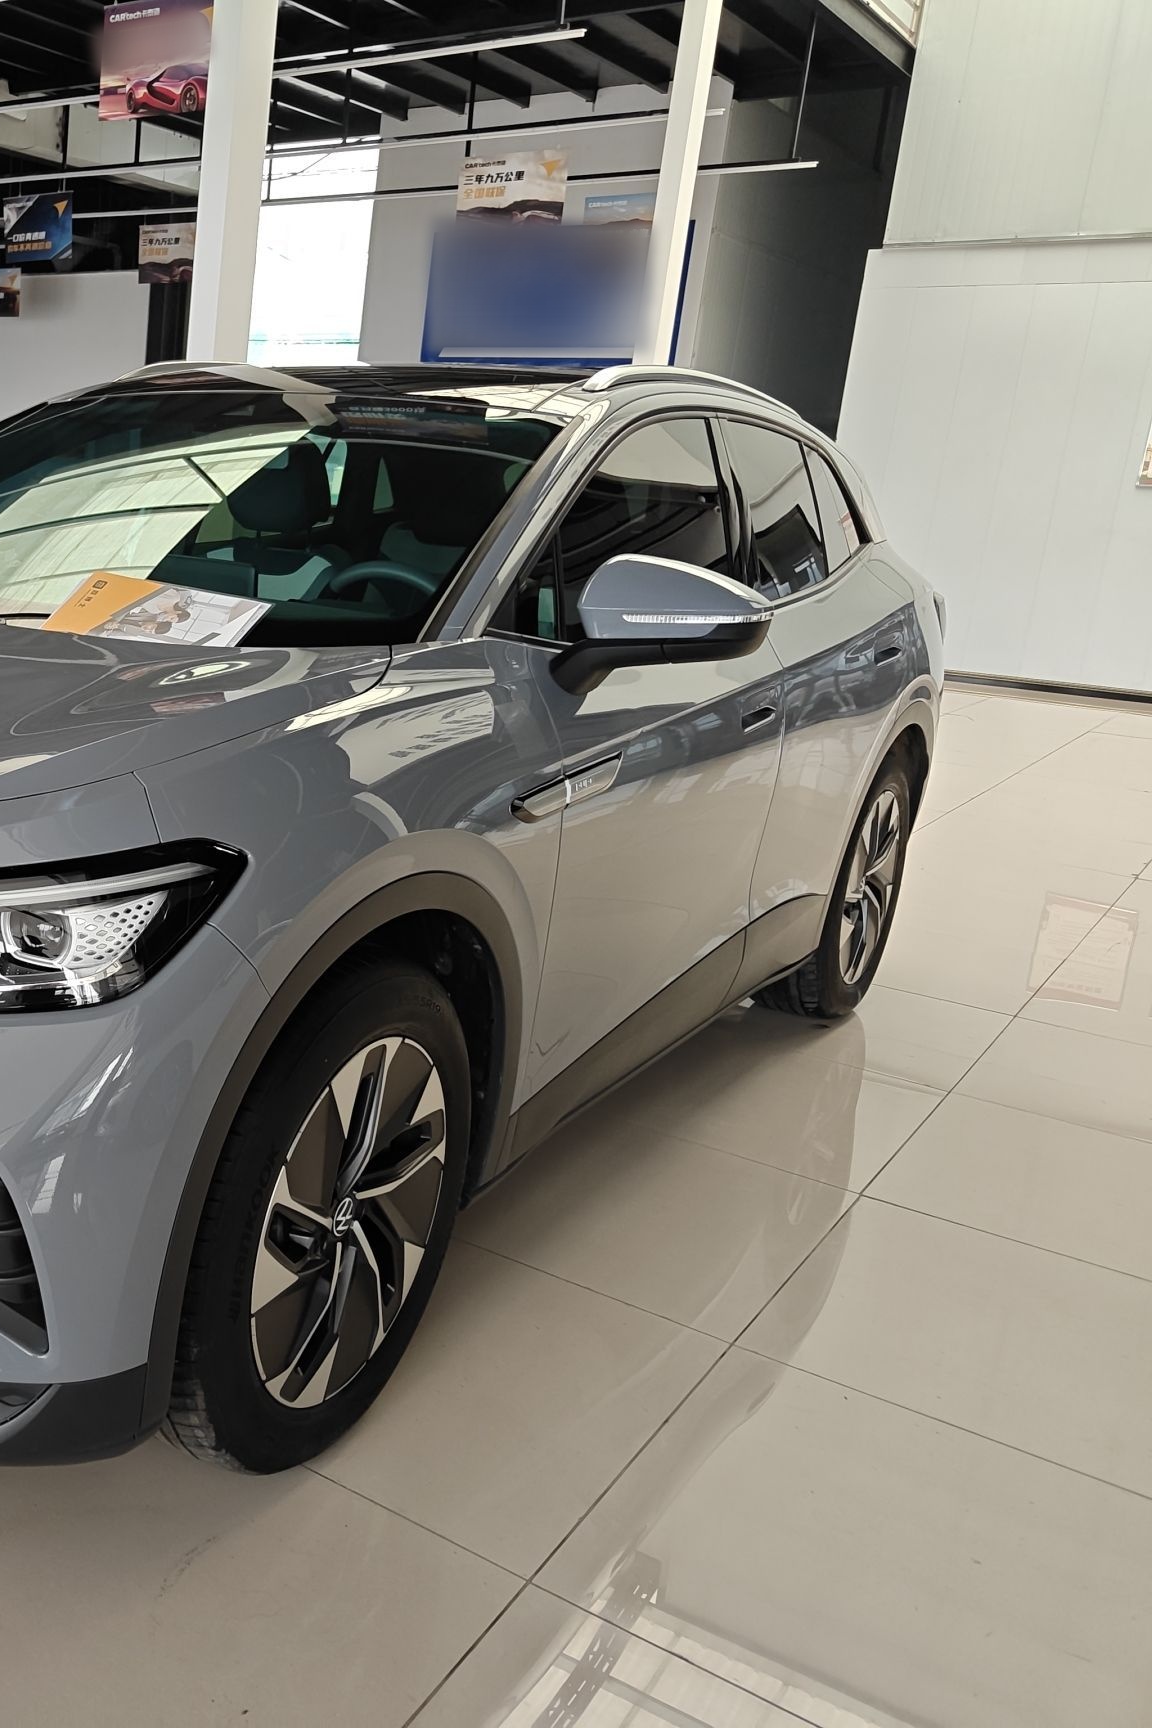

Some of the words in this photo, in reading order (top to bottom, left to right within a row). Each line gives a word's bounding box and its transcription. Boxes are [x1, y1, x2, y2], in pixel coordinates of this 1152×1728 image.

[110, 11, 142, 23] CARtech
[463, 170, 525, 185] 三年九万公里
